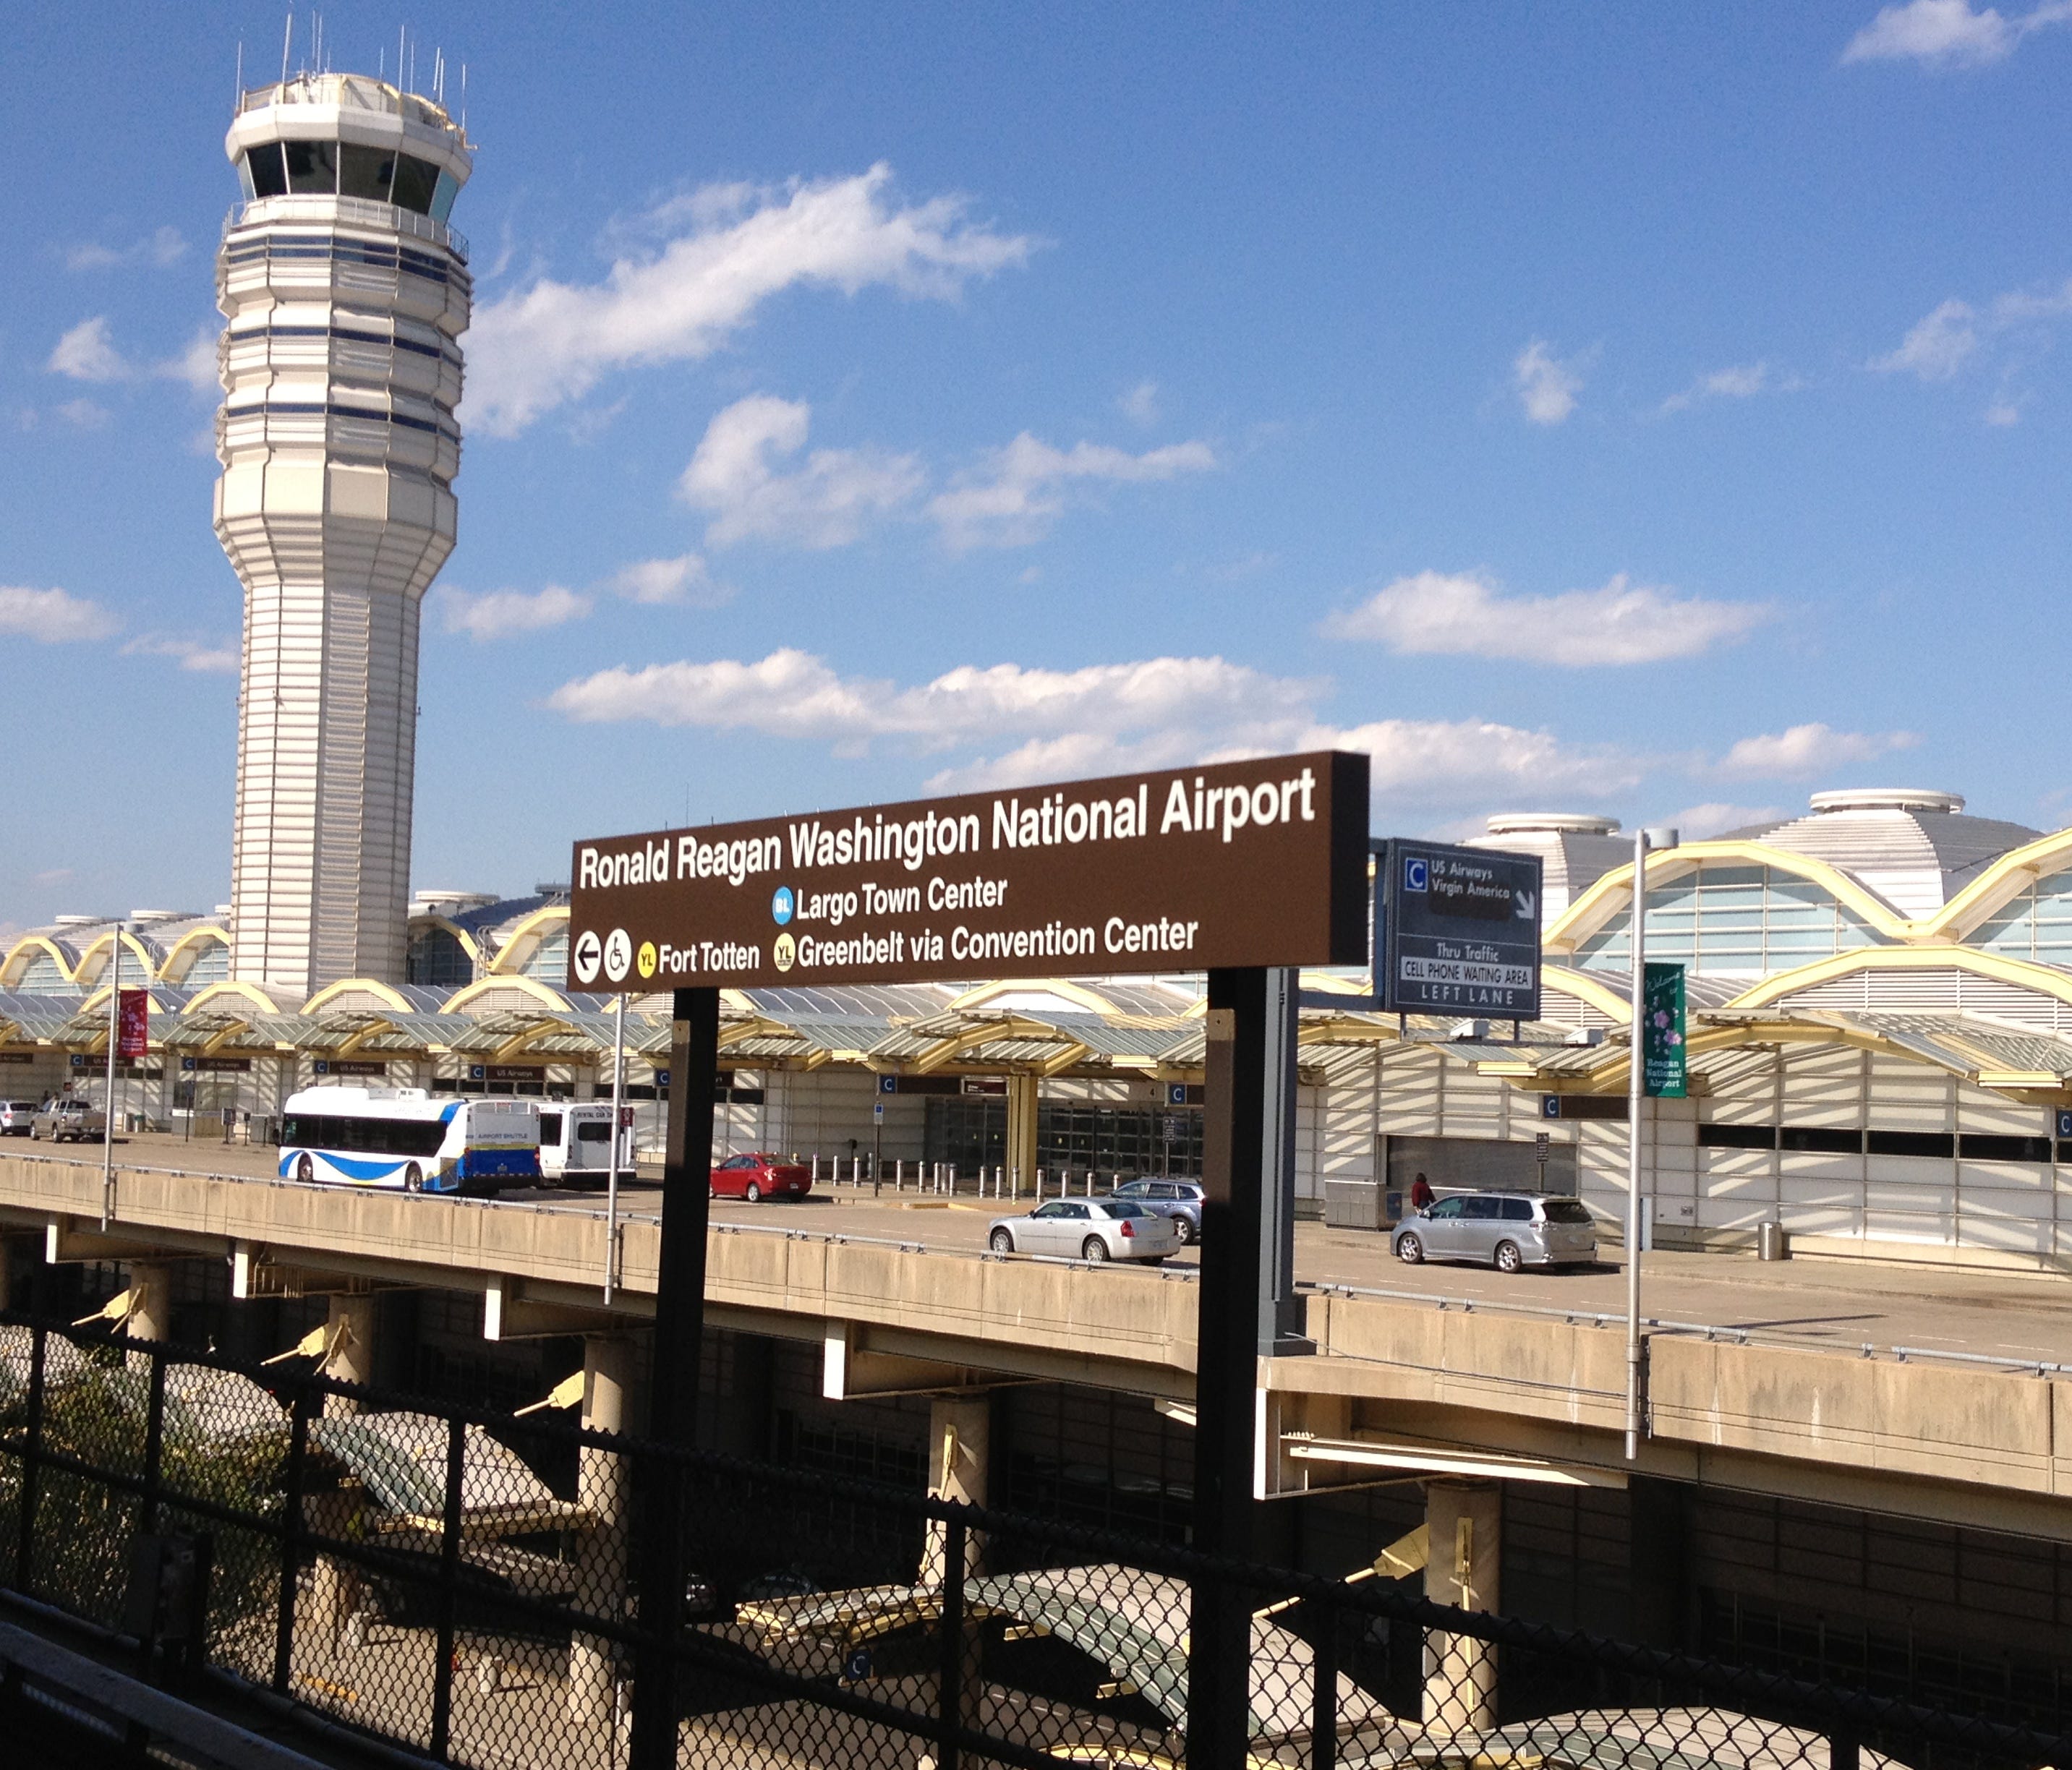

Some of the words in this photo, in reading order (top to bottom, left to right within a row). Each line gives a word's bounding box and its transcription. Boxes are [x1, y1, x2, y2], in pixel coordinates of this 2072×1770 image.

[579, 839, 670, 889] Ronald
[677, 836, 781, 886] Reagan
[789, 811, 980, 871] Washington
[992, 784, 1148, 850] National
[1160, 768, 1316, 843] Airport
[1410, 862, 1424, 888] C
[1431, 860, 1446, 874] US
[1449, 862, 1493, 881] Airways
[1431, 877, 1464, 897] Virgin
[1467, 881, 1510, 899] America
[775, 897, 790, 913] BL
[797, 889, 858, 925] Largo
[861, 883, 921, 915] Town
[927, 876, 1008, 911] Center
[777, 945, 792, 959] YL
[798, 931, 904, 967] Greenbelt
[910, 935, 944, 962] via
[951, 923, 1095, 960] Convention
[1104, 917, 1198, 954] Center
[641, 953, 653, 967] YL
[659, 944, 698, 974] Fort
[700, 941, 760, 972] Totten
[1436, 942, 1461, 959] Thru
[1465, 945, 1499, 962] Traffic
[1405, 960, 1425, 978] CELL
[1428, 963, 1460, 980] PHONE
[1464, 965, 1501, 983] WAITING
[1504, 970, 1528, 986] AREA
[1421, 984, 1461, 1001] LEFT
[1469, 987, 1514, 1006] LANE
[185, 1059, 192, 1068] C
[317, 1063, 325, 1072] C
[473, 1067, 482, 1077] C
[1647, 1058, 1679, 1069] Reagan
[660, 1073, 668, 1083] C
[1646, 1069, 1683, 1077] National
[884, 1079, 893, 1090] C
[1649, 1079, 1680, 1090] Airport
[1172, 1087, 1182, 1101] C
[1548, 1099, 1557, 1115] C
[2061, 1116, 2070, 1133] C
